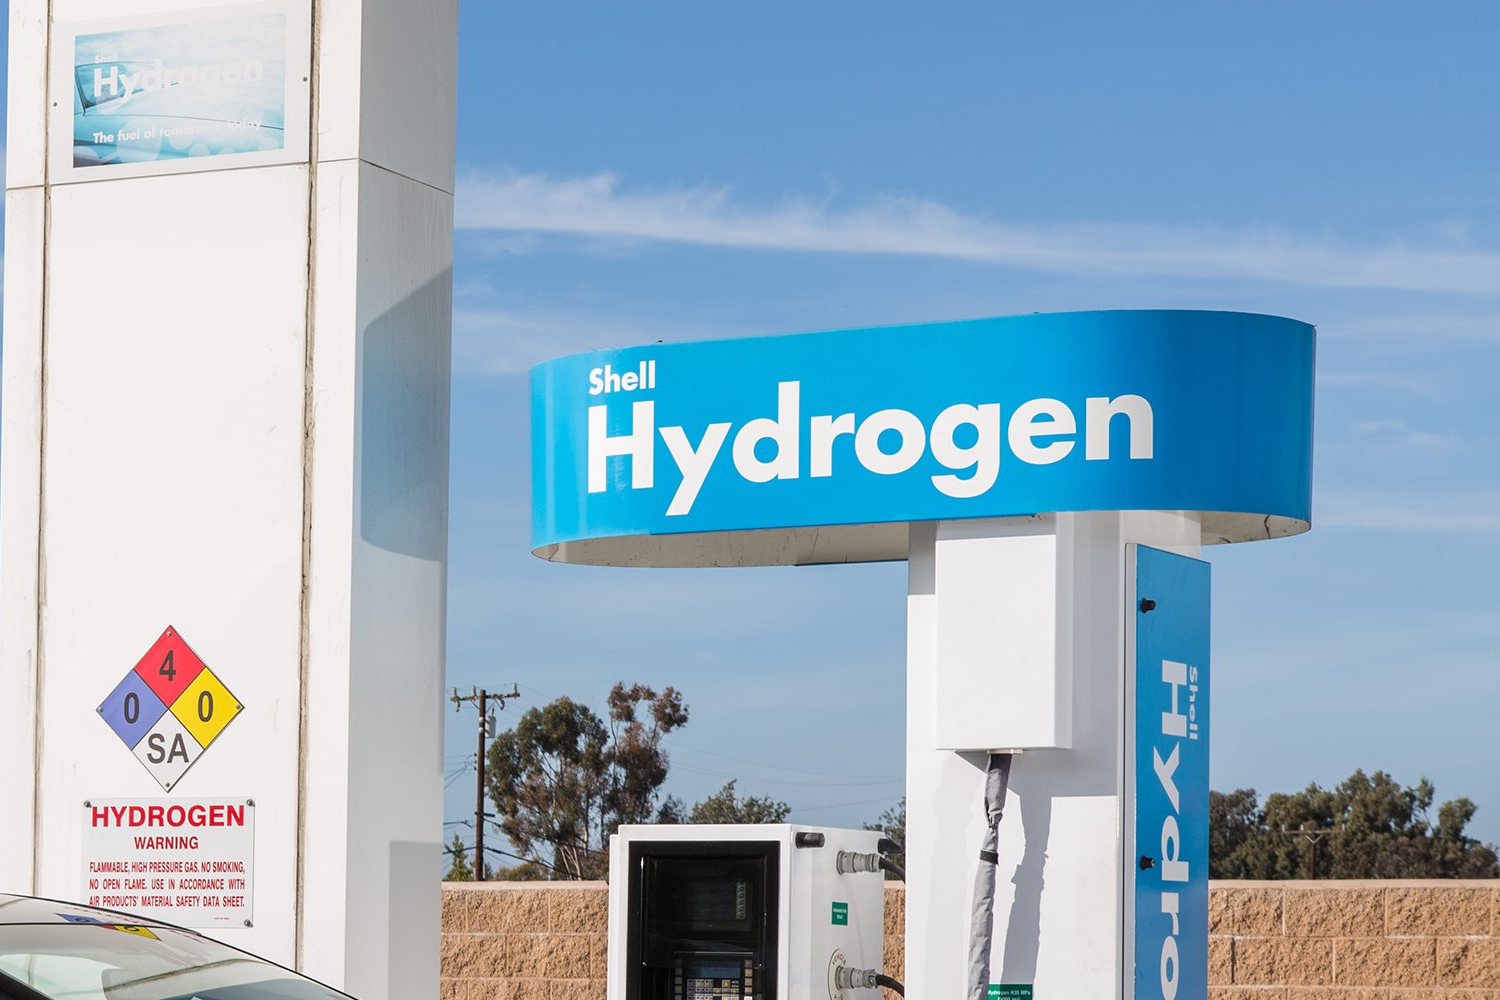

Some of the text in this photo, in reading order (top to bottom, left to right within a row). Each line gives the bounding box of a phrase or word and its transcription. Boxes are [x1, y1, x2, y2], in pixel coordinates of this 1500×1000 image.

[95, 53, 118, 64] Shell
[93, 58, 264, 103] Hydrogen
[93, 132, 114, 145] The
[117, 128, 140, 141] fuel
[144, 125, 157, 138] of
[588, 360, 656, 396] Shell
[587, 381, 1155, 517] Hydrogen
[158, 650, 176, 681] 4
[123, 690, 214, 724] 0 0
[1188, 665, 1199, 740] Shell
[147, 733, 189, 764] SA
[91, 805, 245, 828] HYDROGEN
[134, 836, 199, 850] WARNING
[89, 861, 245, 874] FLAMMABLE, HIGH PRESSURE GAS. NO SMOKING,
[89, 879, 245, 890] NO OPEN FLAME. USE IN ACCORDANCE WITH
[89, 896, 99, 907] AIR
[141, 896, 173, 907] MATERIAL
[176, 896, 200, 907] SAFETY
[203, 896, 220, 907] DATA
[222, 896, 245, 907] SHEET.
